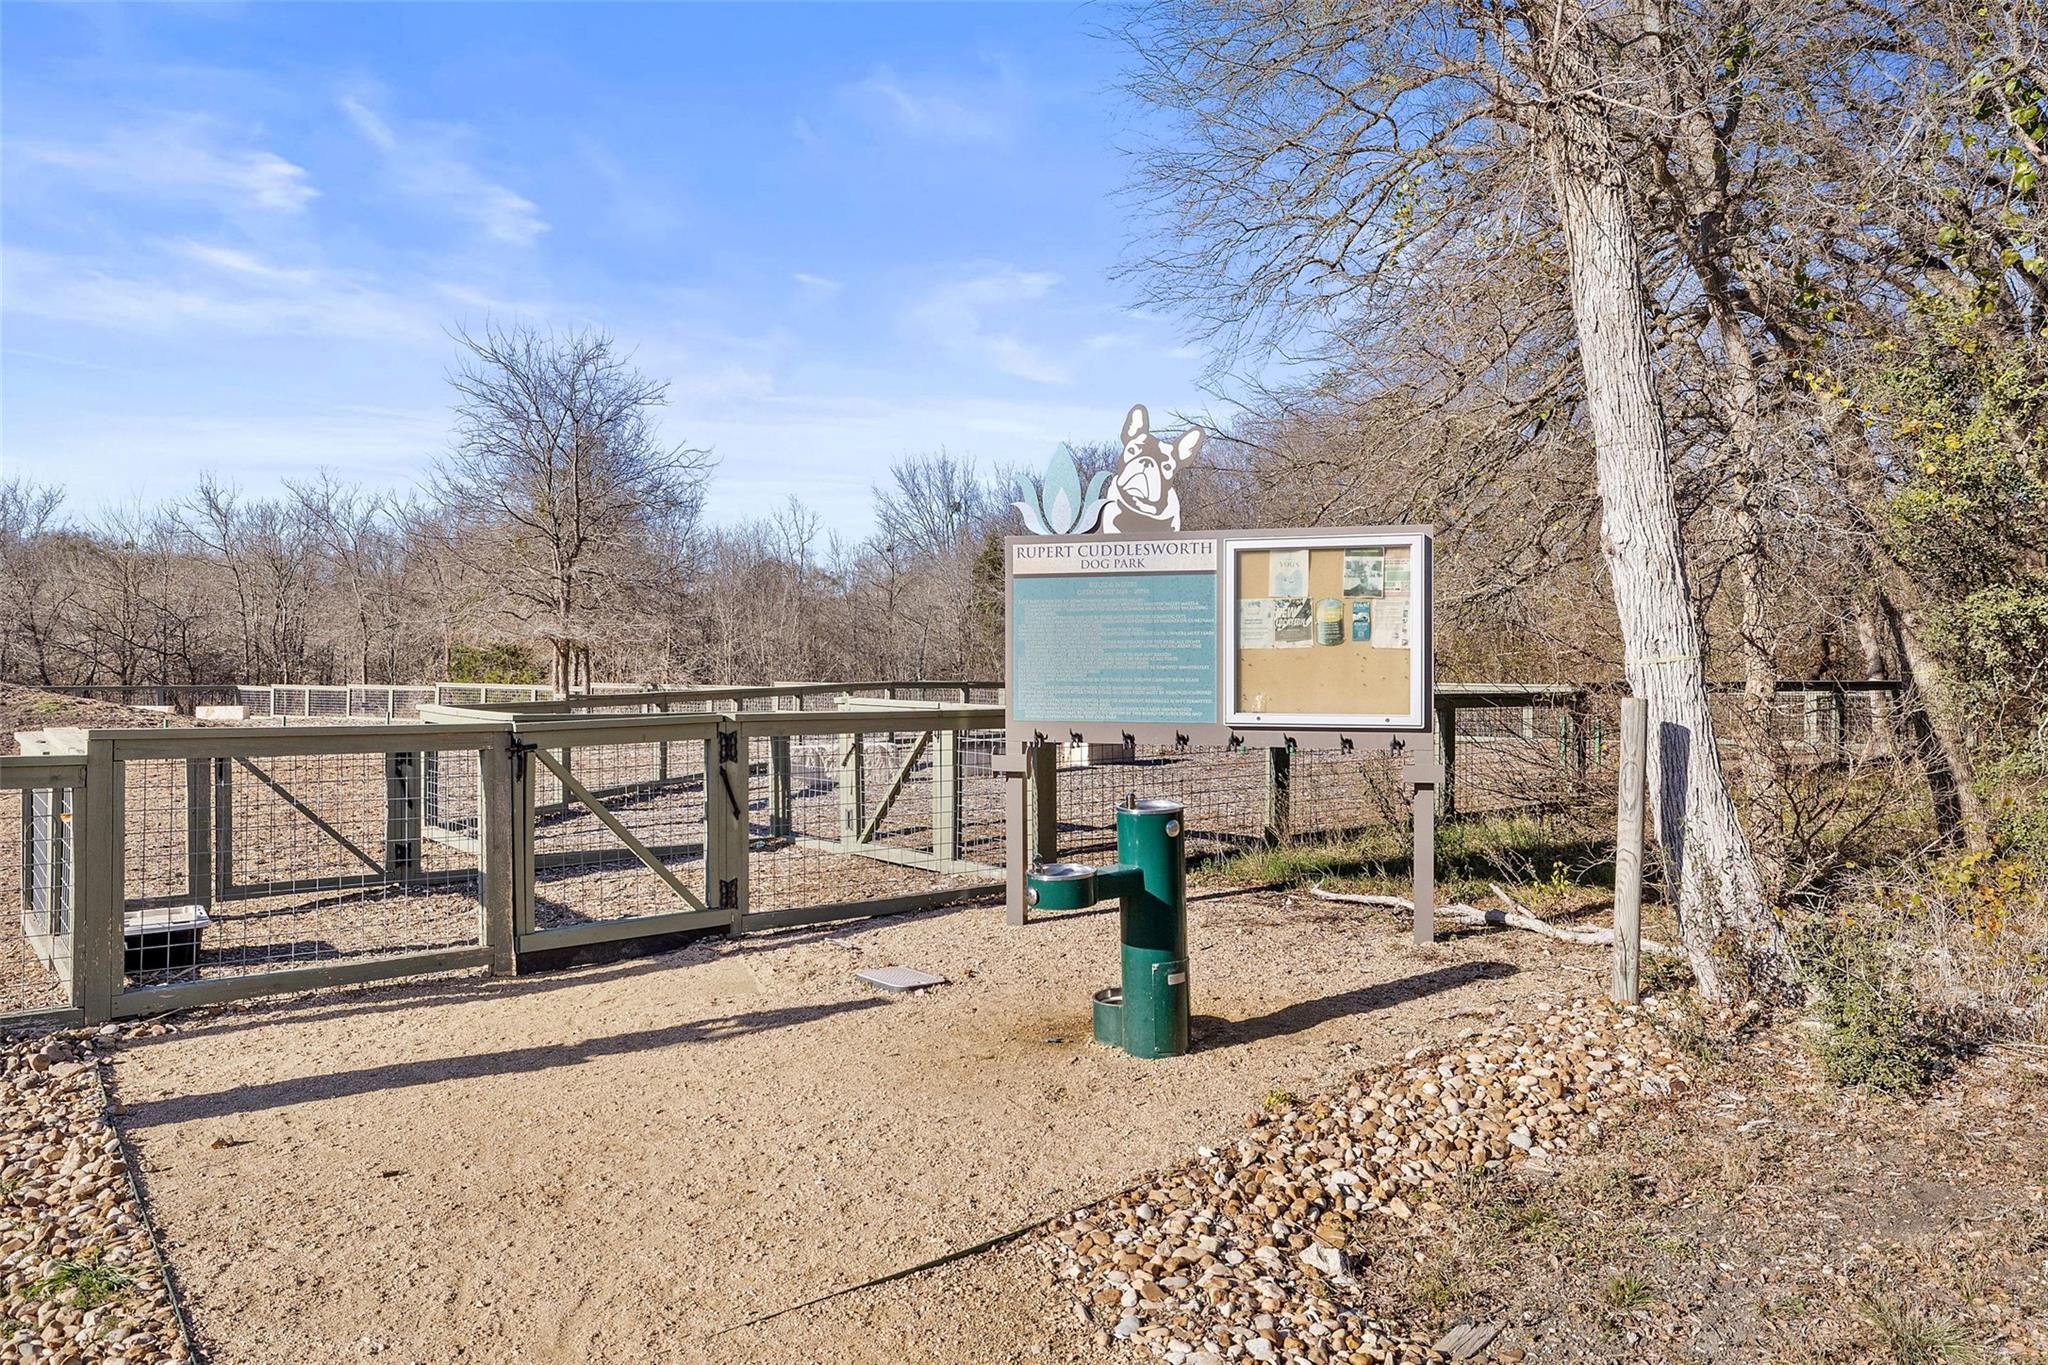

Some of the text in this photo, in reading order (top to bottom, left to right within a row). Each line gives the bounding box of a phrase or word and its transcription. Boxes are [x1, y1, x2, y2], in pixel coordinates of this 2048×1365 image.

[1017, 542, 1212, 559] RUPERT CUDDLESWORTH
[1081, 558, 1145, 569] DOG PARK
